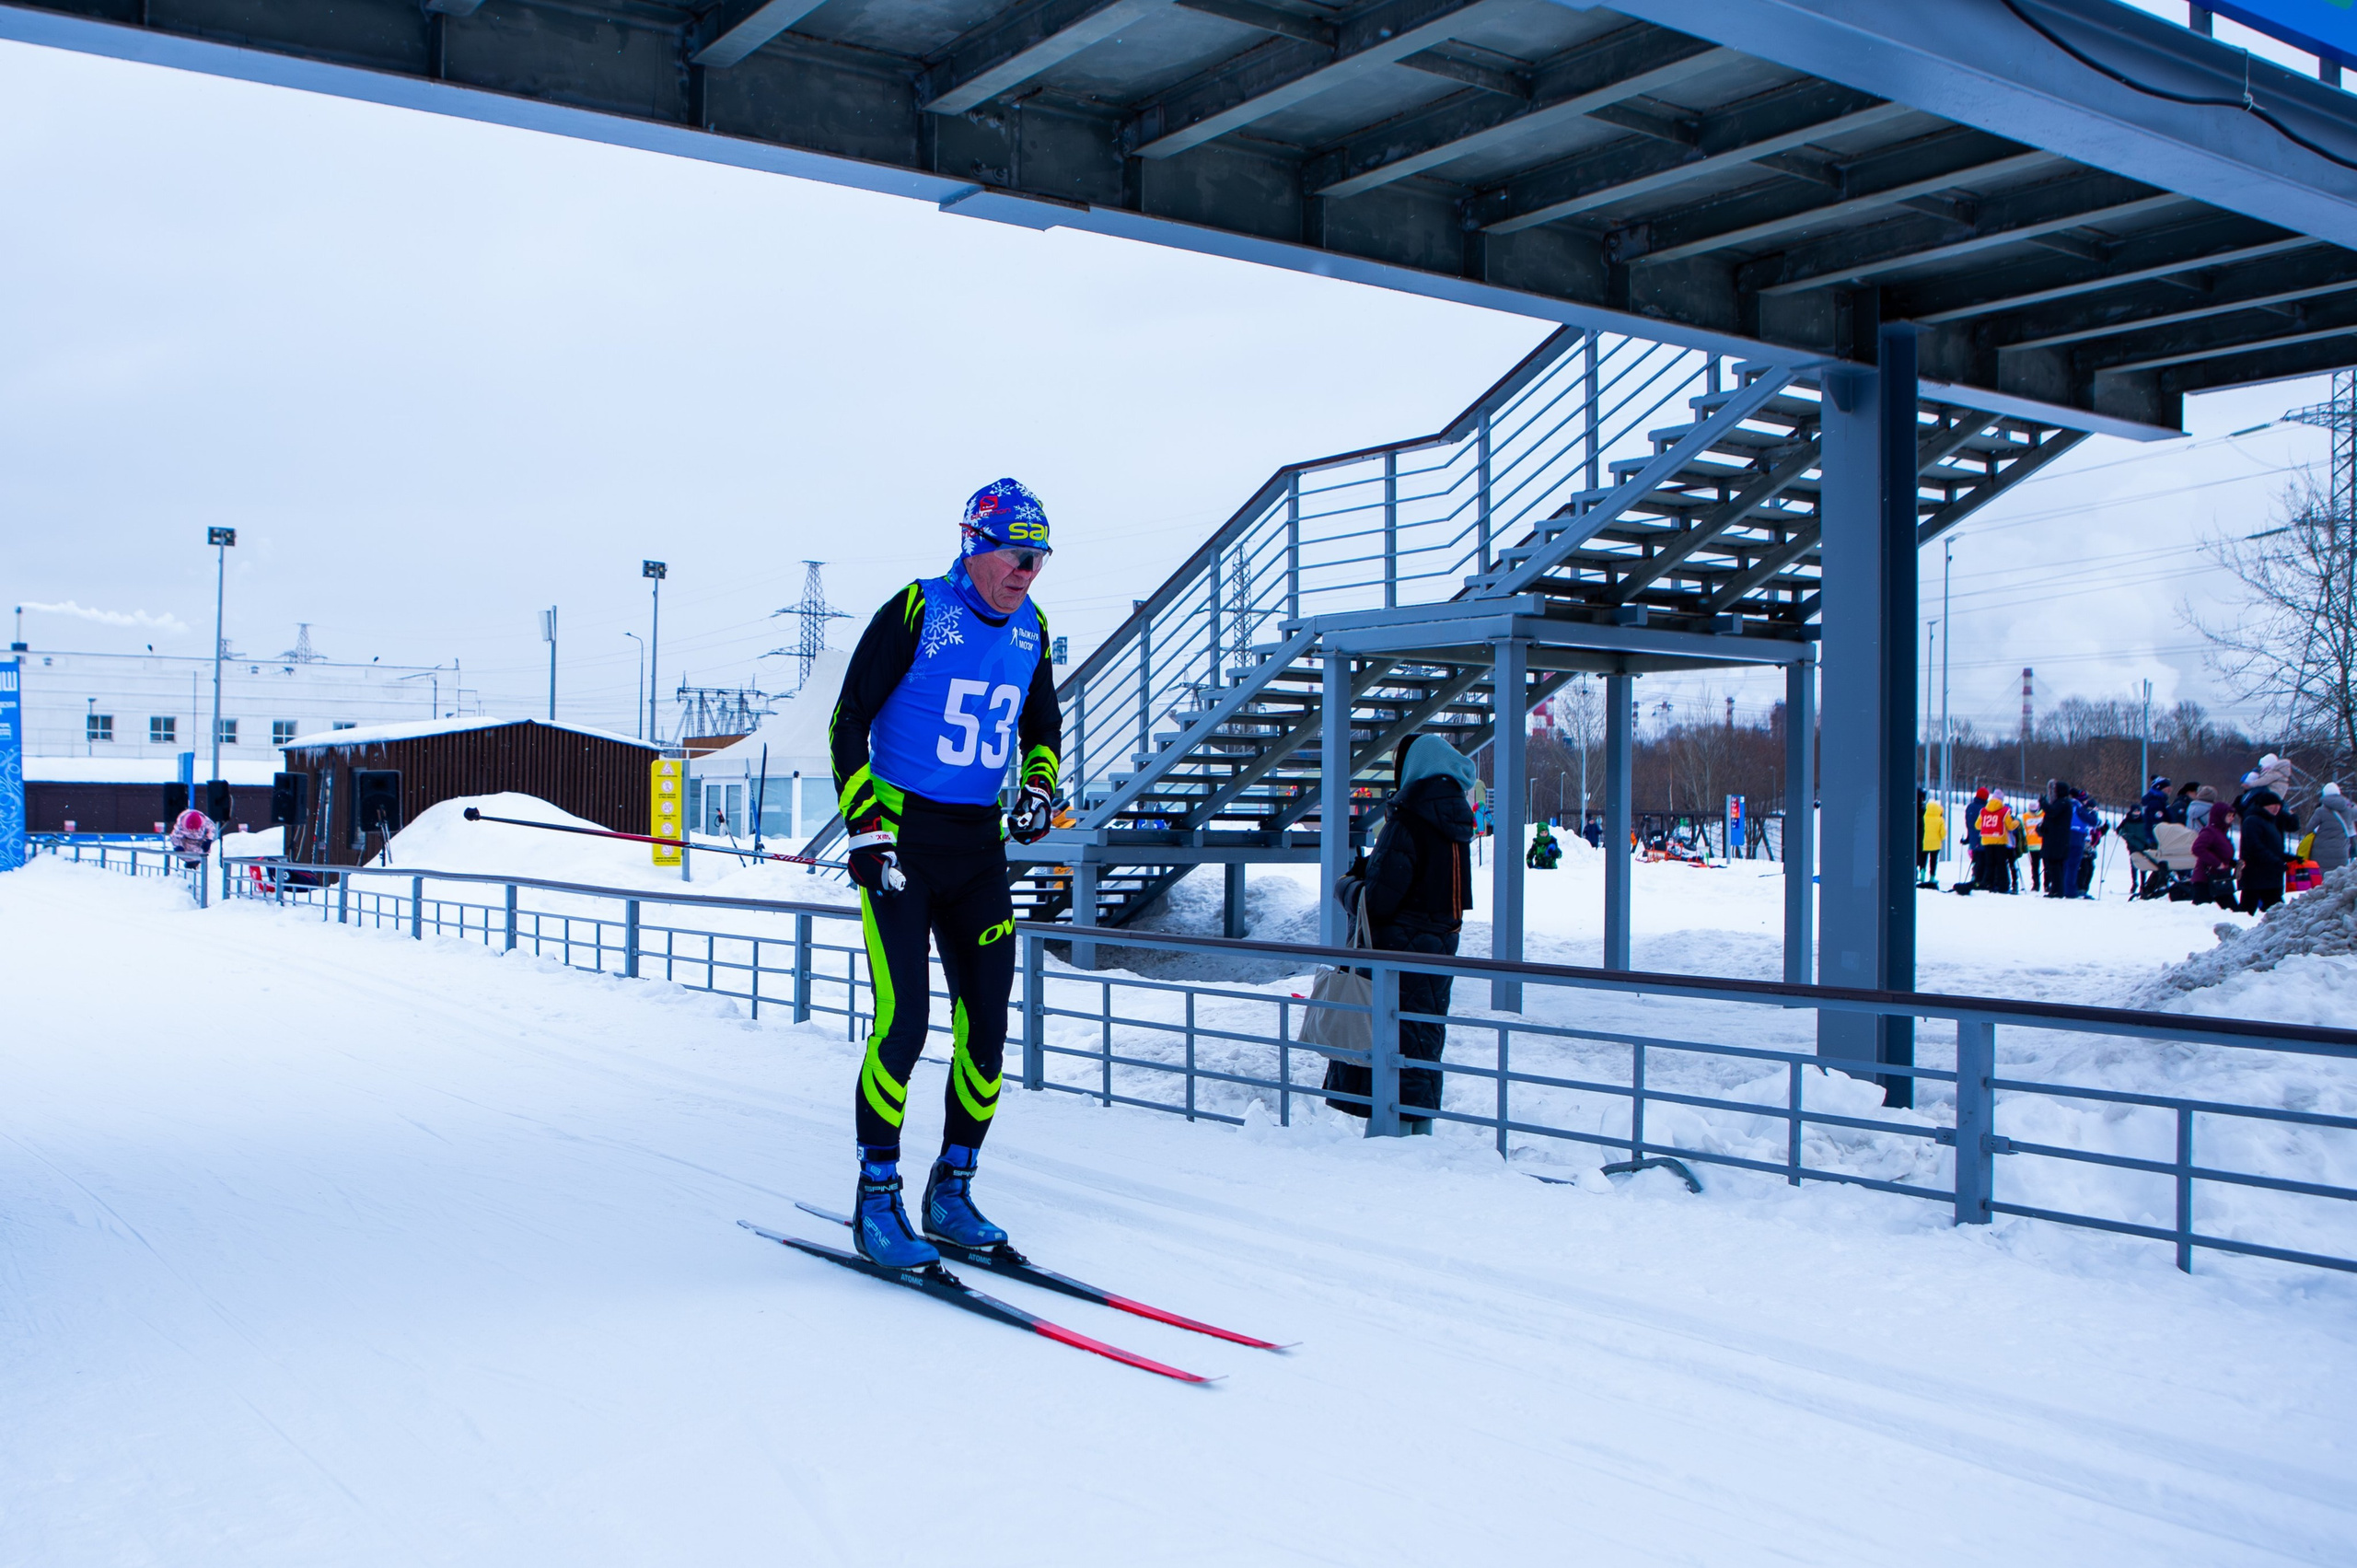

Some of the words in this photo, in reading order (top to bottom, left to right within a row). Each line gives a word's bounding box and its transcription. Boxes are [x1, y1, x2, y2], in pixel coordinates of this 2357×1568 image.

[936, 678, 1021, 770] 53
[1982, 814, 1999, 828] 129
[864, 1182, 899, 1193] SPINE
[863, 1215, 891, 1249] SPINE
[968, 1252, 992, 1266] ATOMIC
[900, 1272, 923, 1287] ATOMIC
